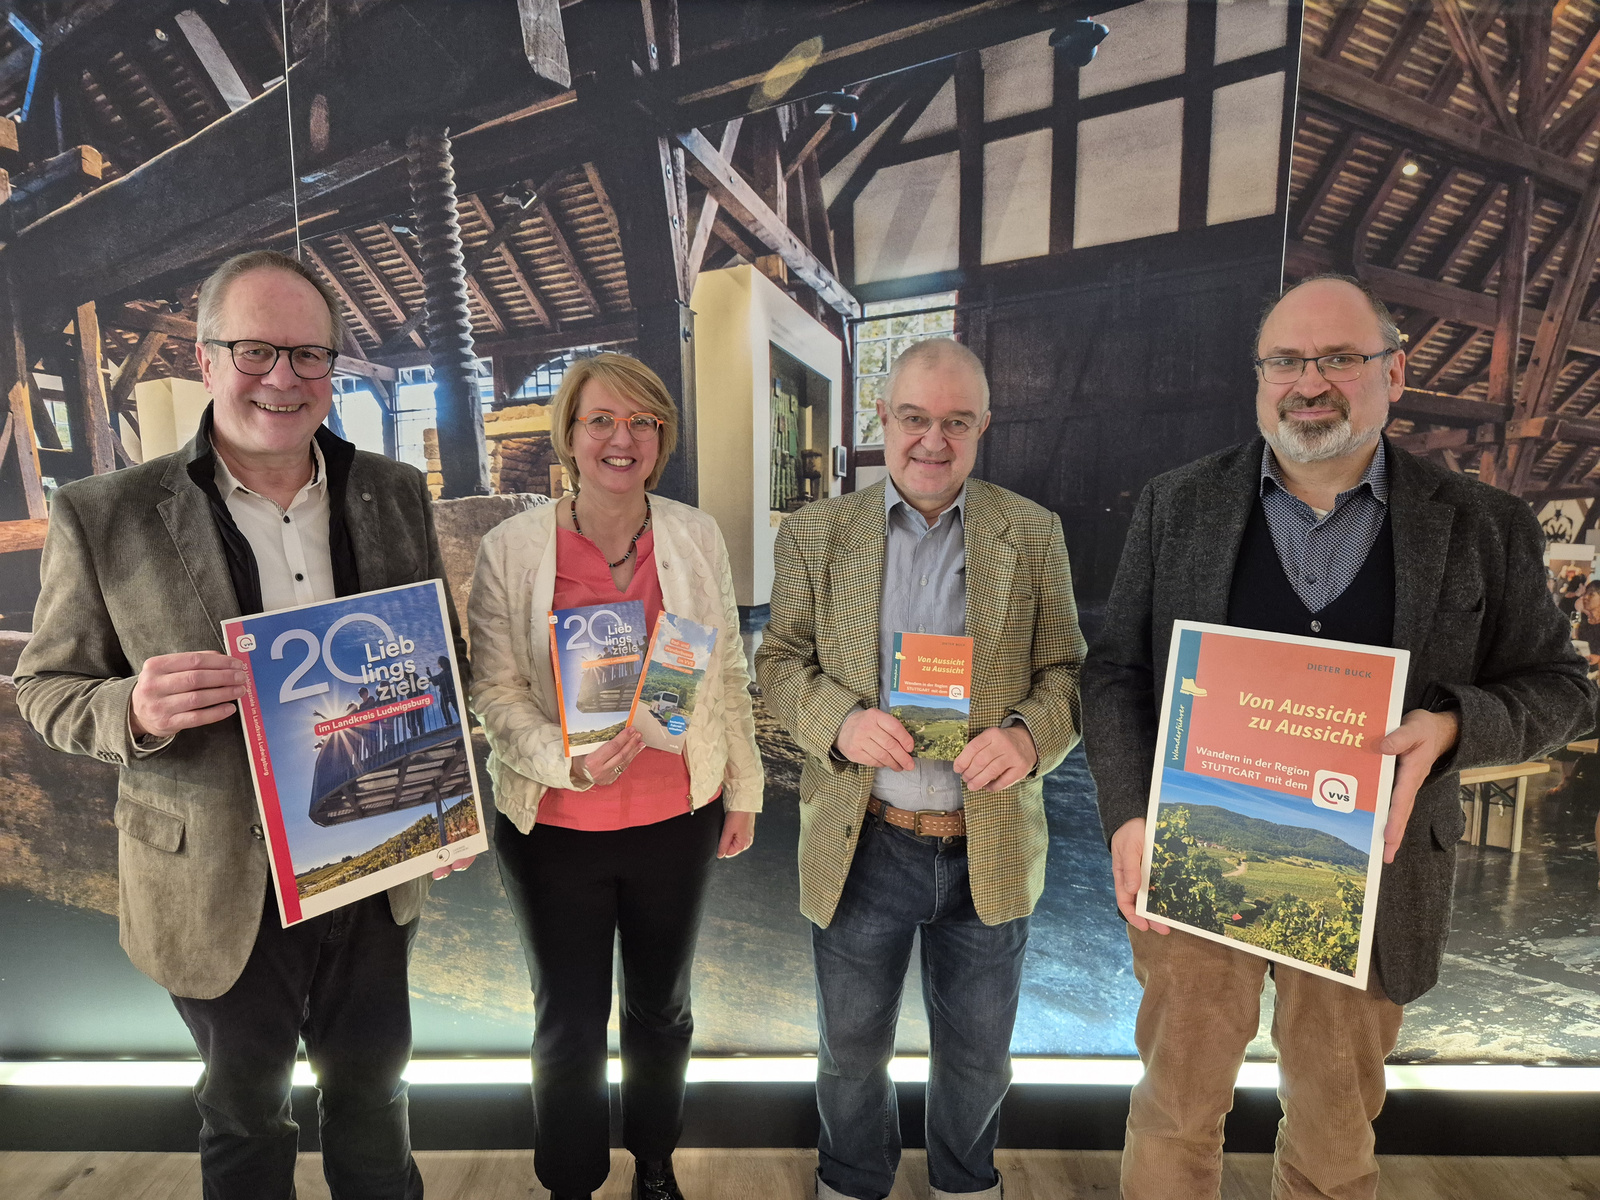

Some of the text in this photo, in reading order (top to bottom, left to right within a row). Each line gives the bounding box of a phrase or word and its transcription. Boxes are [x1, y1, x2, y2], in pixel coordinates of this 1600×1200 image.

[563, 609, 623, 651] 20
[604, 635, 632, 647] lings
[607, 623, 632, 635] Lieb
[270, 612, 396, 704] 20
[365, 635, 415, 663] Lieb
[612, 644, 638, 655] ziele
[917, 655, 965, 666] Von Aussicht
[361, 659, 416, 684] lings
[932, 665, 965, 675] Aussicht
[1307, 662, 1372, 678] DIETER BUCK
[377, 674, 430, 702] ziele
[318, 697, 431, 733] im Landkreis Ludwigsburg
[1238, 691, 1368, 727] Von Aussicht
[252, 715, 263, 741] Landkreis
[258, 742, 269, 776] Ludwigsburg
[1171, 704, 1186, 761] Wanderführer
[1248, 716, 1365, 748] zu Aussicht
[1195, 746, 1310, 777] Wandern in der Region
[1201, 760, 1308, 791] STUTTGART mit dem
